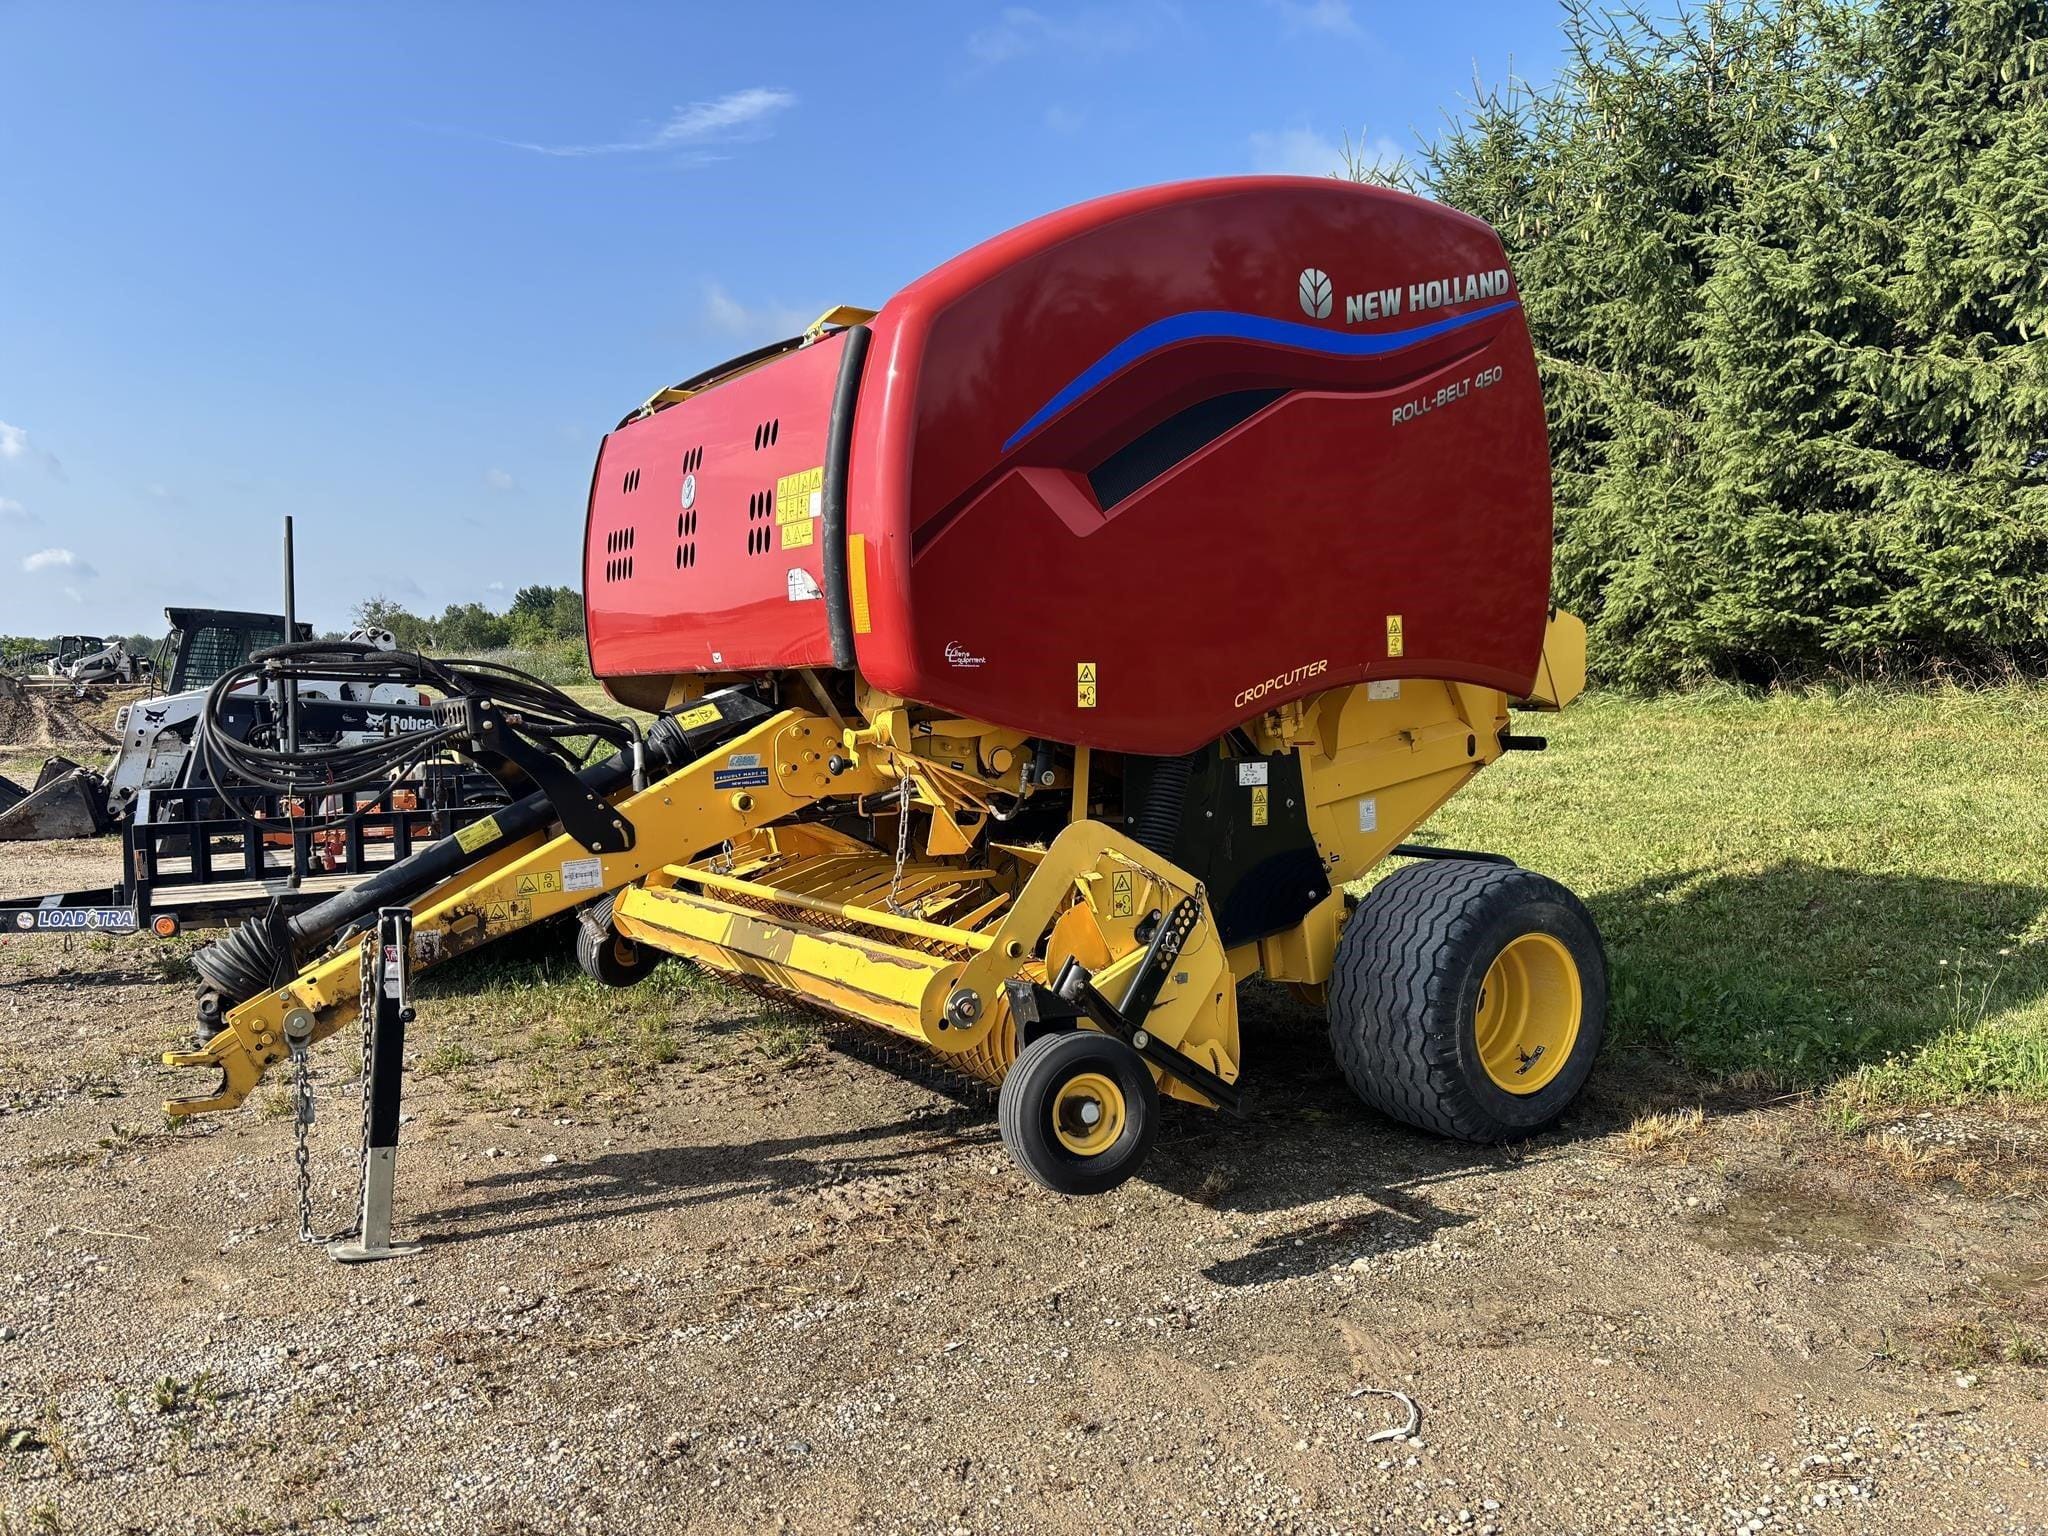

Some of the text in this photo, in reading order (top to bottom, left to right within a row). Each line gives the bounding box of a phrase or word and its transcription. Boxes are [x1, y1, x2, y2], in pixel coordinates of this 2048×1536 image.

[1346, 269, 1510, 324] NEW HOLLAND
[1392, 365, 1503, 426] ROLL-BELT 450
[1234, 659, 1328, 708] CROPCUTTER
[390, 715, 434, 732] Bobca
[38, 910, 136, 927] LOAD TRA
